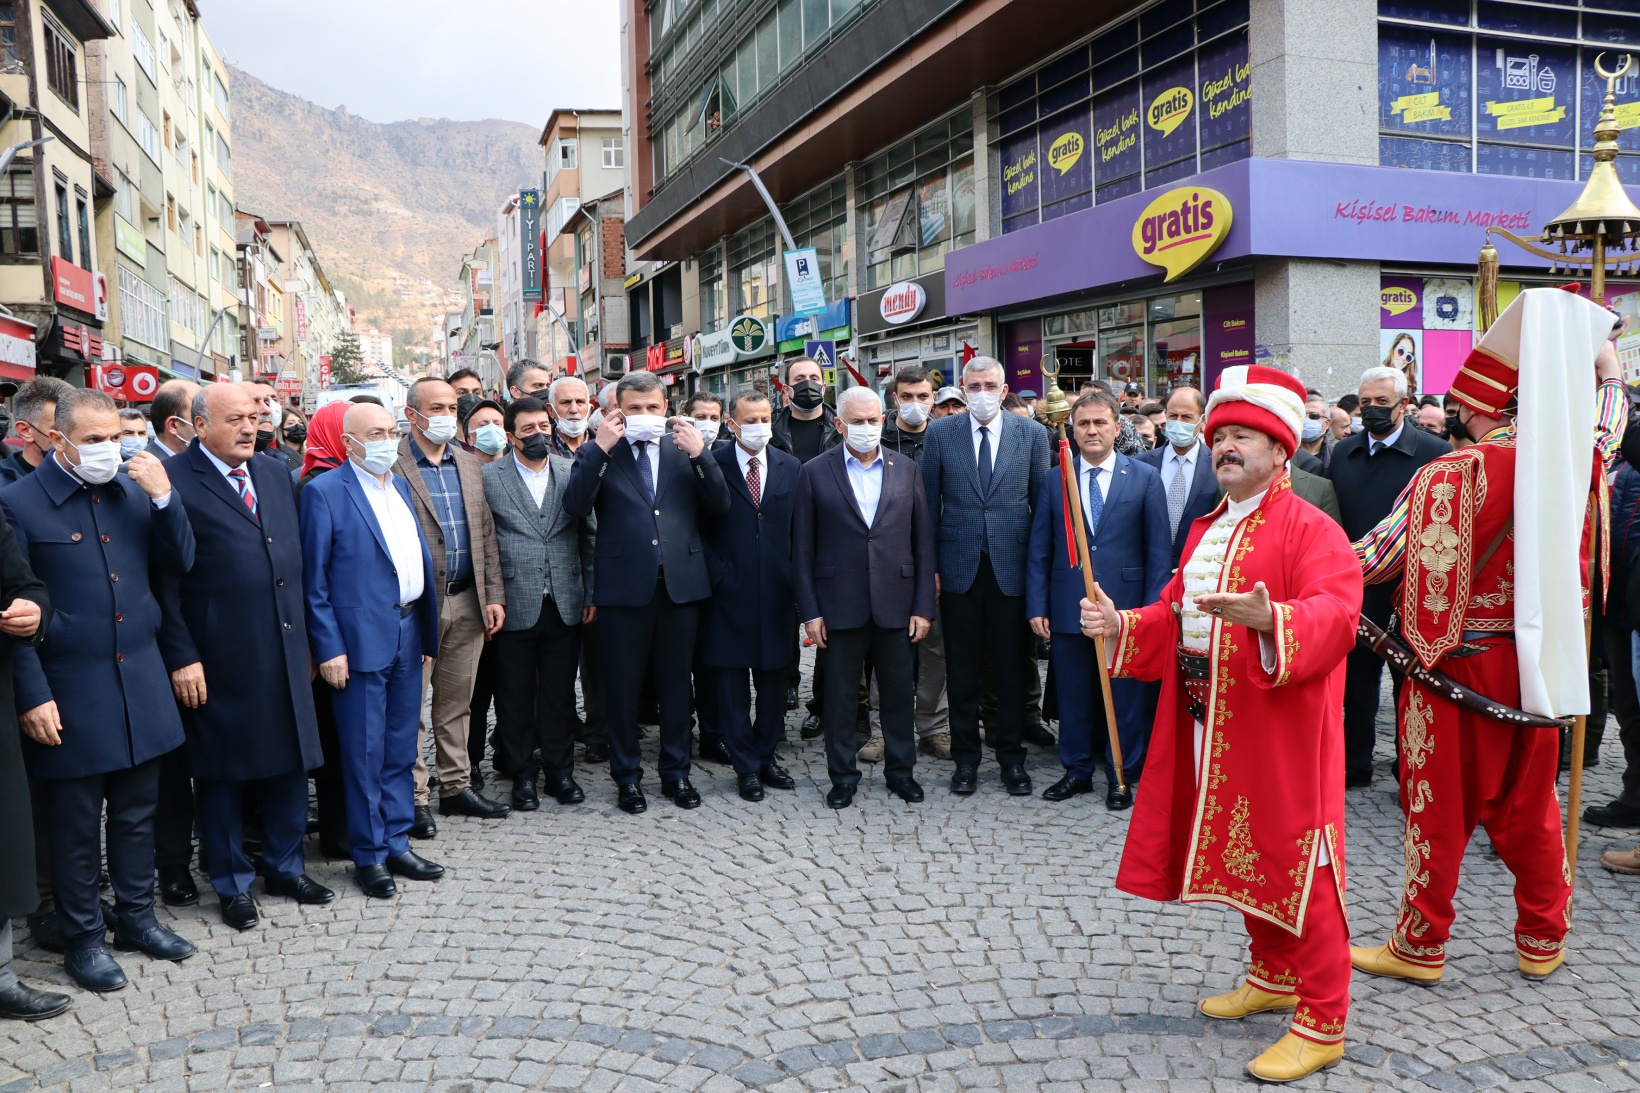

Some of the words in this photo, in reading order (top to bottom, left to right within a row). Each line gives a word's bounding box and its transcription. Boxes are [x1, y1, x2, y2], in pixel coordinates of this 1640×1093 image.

[1203, 68, 1233, 102] Güzel
[1236, 63, 1250, 83] ba
[1152, 90, 1188, 125] gratis
[1413, 108, 1435, 120] BAKIM
[1096, 119, 1120, 147] Güzel
[1122, 108, 1139, 130] bak
[1051, 135, 1080, 164] gratis
[1102, 133, 1136, 162] kendine
[1003, 158, 1022, 181] Güzel
[1022, 150, 1037, 169] bak
[1007, 172, 1034, 195] kendine
[1141, 192, 1214, 255] gratis
[1334, 199, 1398, 226] Kişisel
[1402, 204, 1460, 224] Bakım
[1463, 209, 1532, 229] Marketi
[883, 284, 917, 313] mendy
[1381, 290, 1413, 306] gratis
